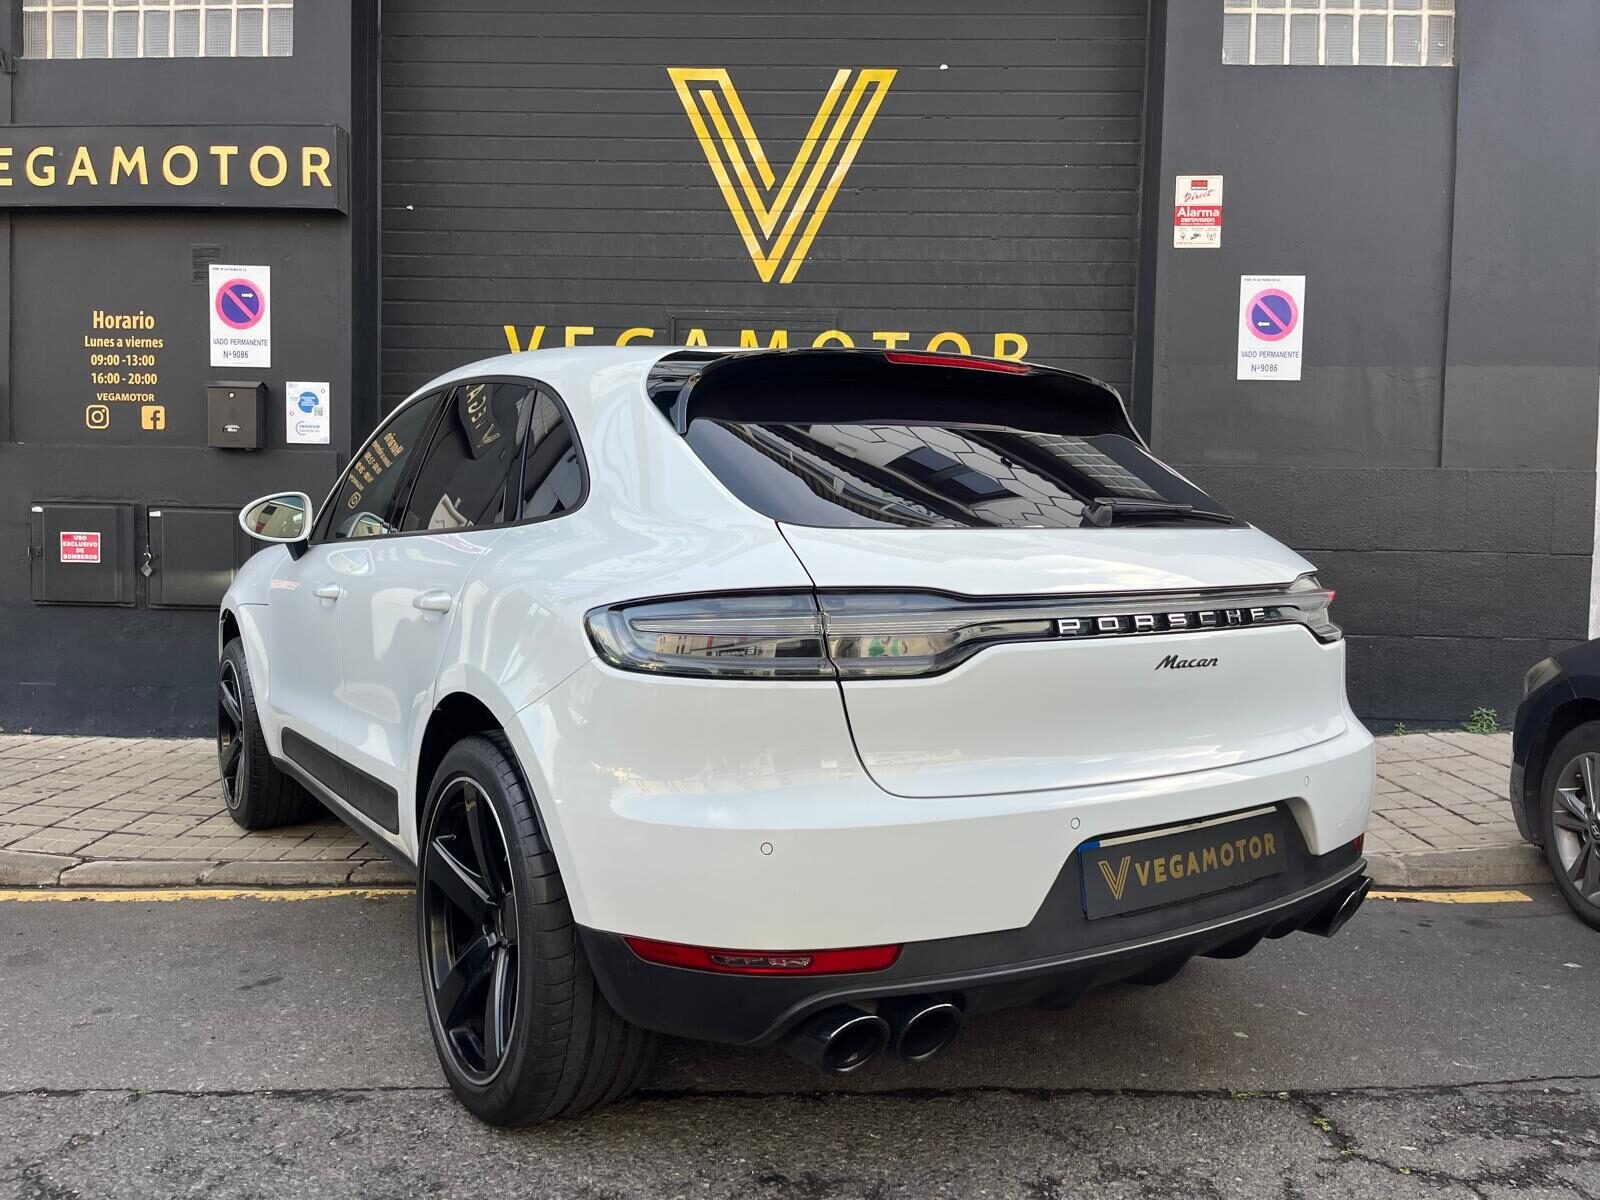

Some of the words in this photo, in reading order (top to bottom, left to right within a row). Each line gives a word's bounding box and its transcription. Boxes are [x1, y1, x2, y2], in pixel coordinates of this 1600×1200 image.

[1177, 206, 1220, 217] Alarma
[93, 310, 155, 329] Horario
[84, 335, 115, 347] Lunes
[116, 339, 123, 347] a
[125, 335, 164, 348] viernes
[230, 338, 268, 346] PERMANENTE
[90, 354, 120, 366] 09:00
[1241, 350, 1257, 358] VADO
[1259, 350, 1300, 358] PERMANENTE
[91, 372, 120, 384] 16:00
[128, 373, 158, 385] 20:00
[96, 393, 155, 402] VEGAMOTOR
[1057, 607, 1265, 635] PORSCHE
[1154, 654, 1218, 671] Macan
[1134, 832, 1277, 887] VEGAMOTOR
